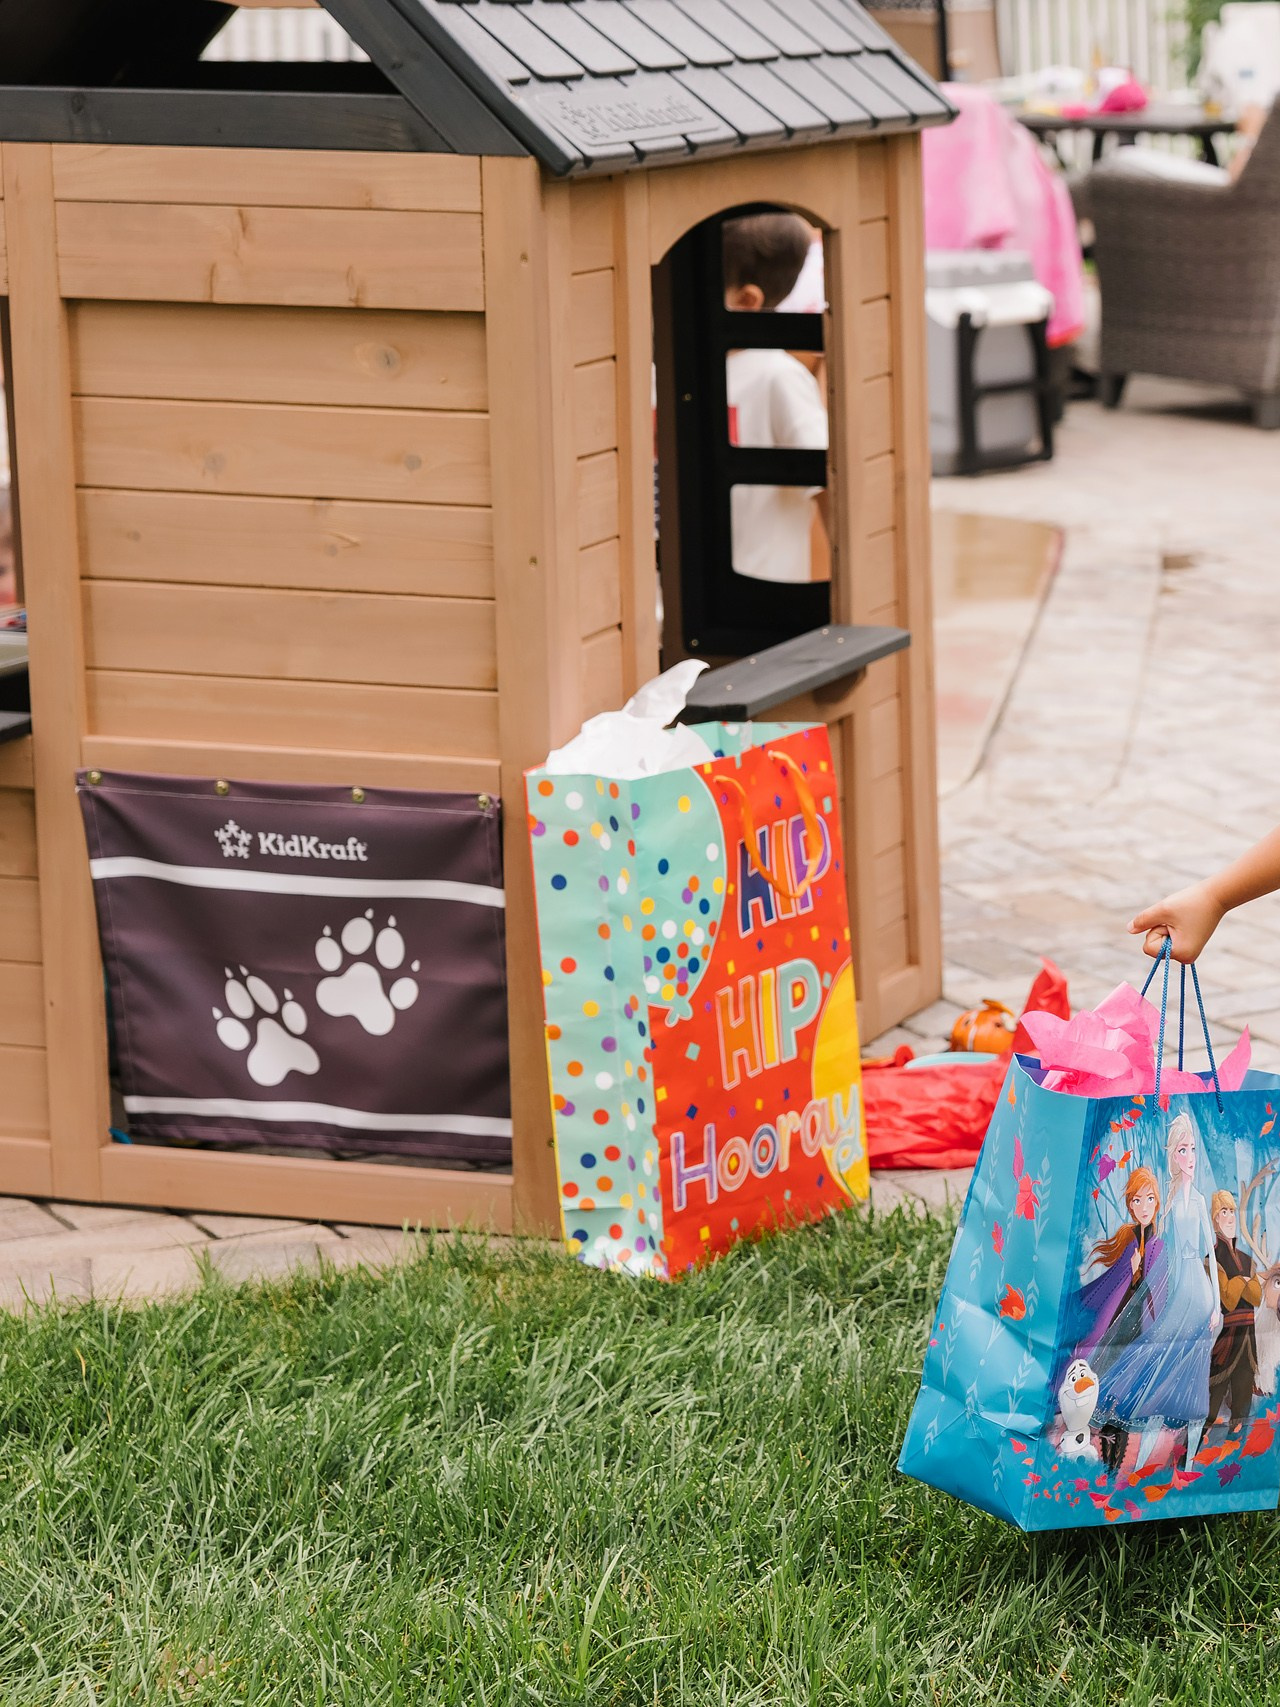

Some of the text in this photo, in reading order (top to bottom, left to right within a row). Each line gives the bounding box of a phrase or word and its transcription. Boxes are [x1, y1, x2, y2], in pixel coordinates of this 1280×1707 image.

[258, 832, 369, 862] KidKraft
[737, 813, 832, 939] HIP
[716, 957, 823, 1091] HIP
[670, 1086, 863, 1212] Hooray
